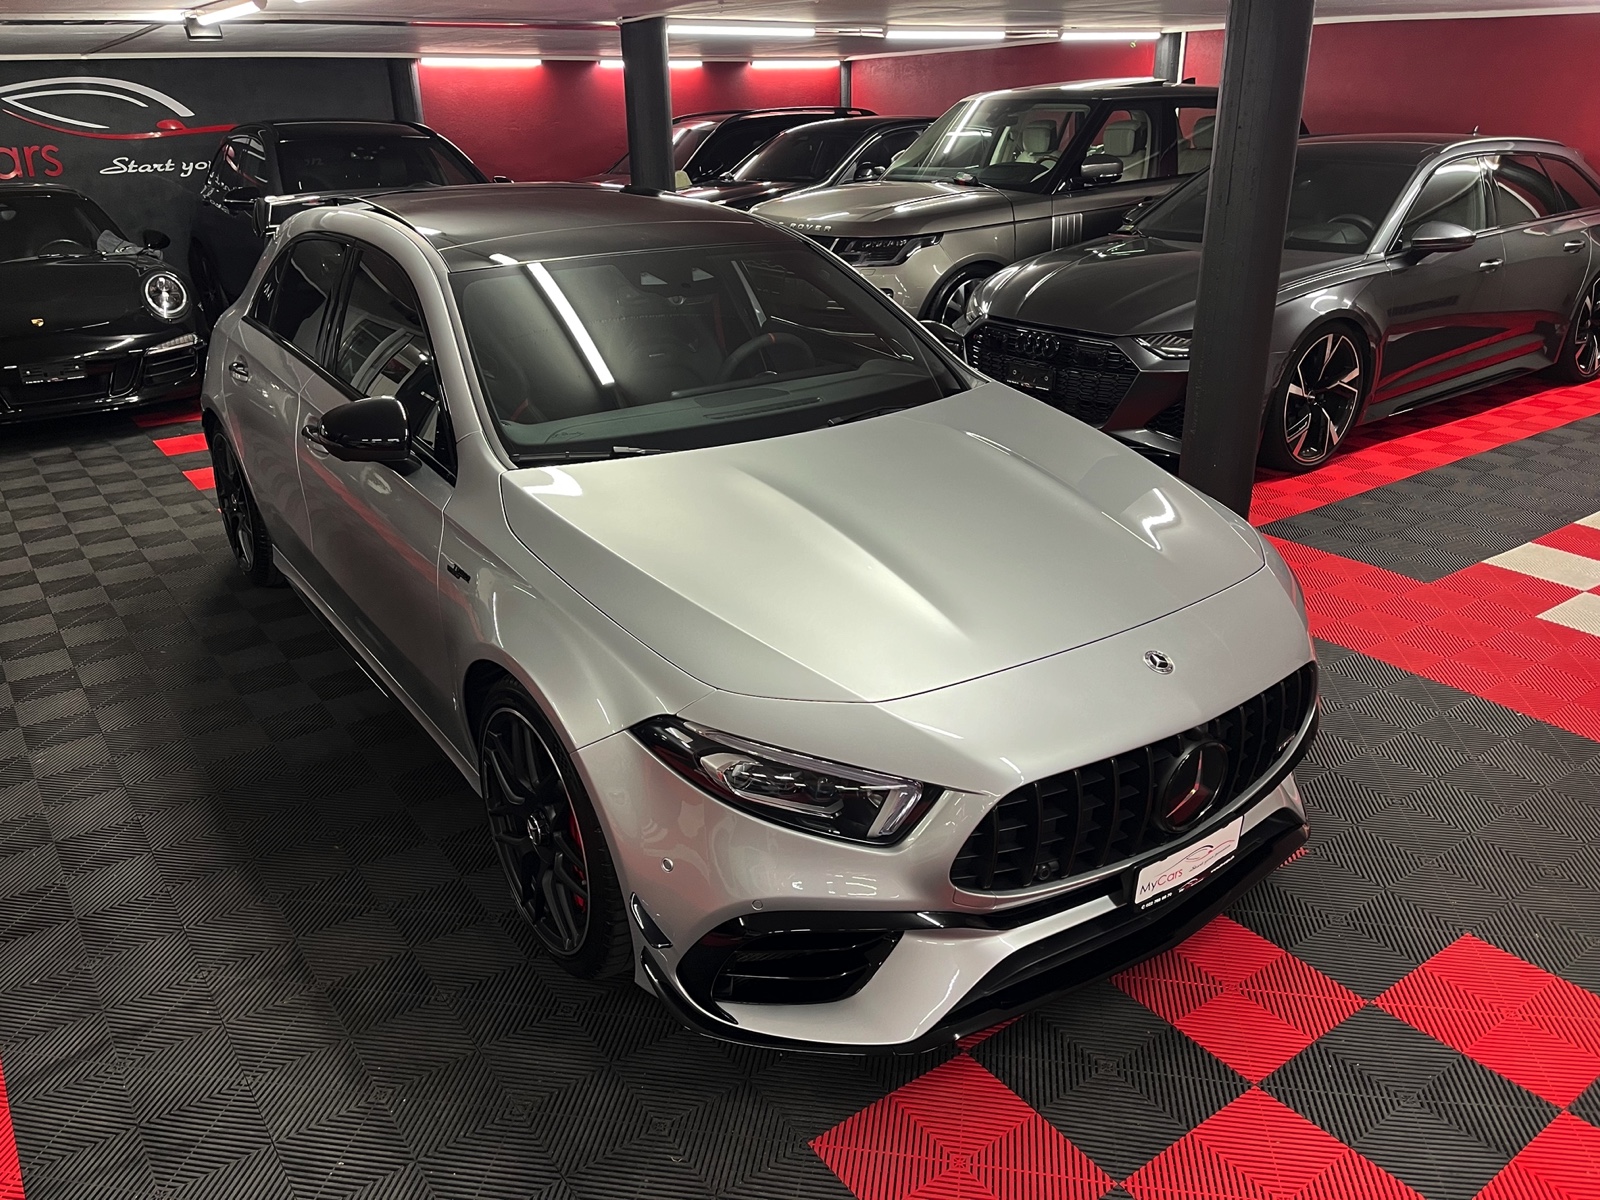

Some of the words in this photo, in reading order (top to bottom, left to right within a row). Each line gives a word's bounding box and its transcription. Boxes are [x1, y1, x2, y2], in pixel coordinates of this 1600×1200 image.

[99, 156, 176, 175] Start
[789, 222, 832, 232] ROVER
[1139, 869, 1183, 895] MyCars
